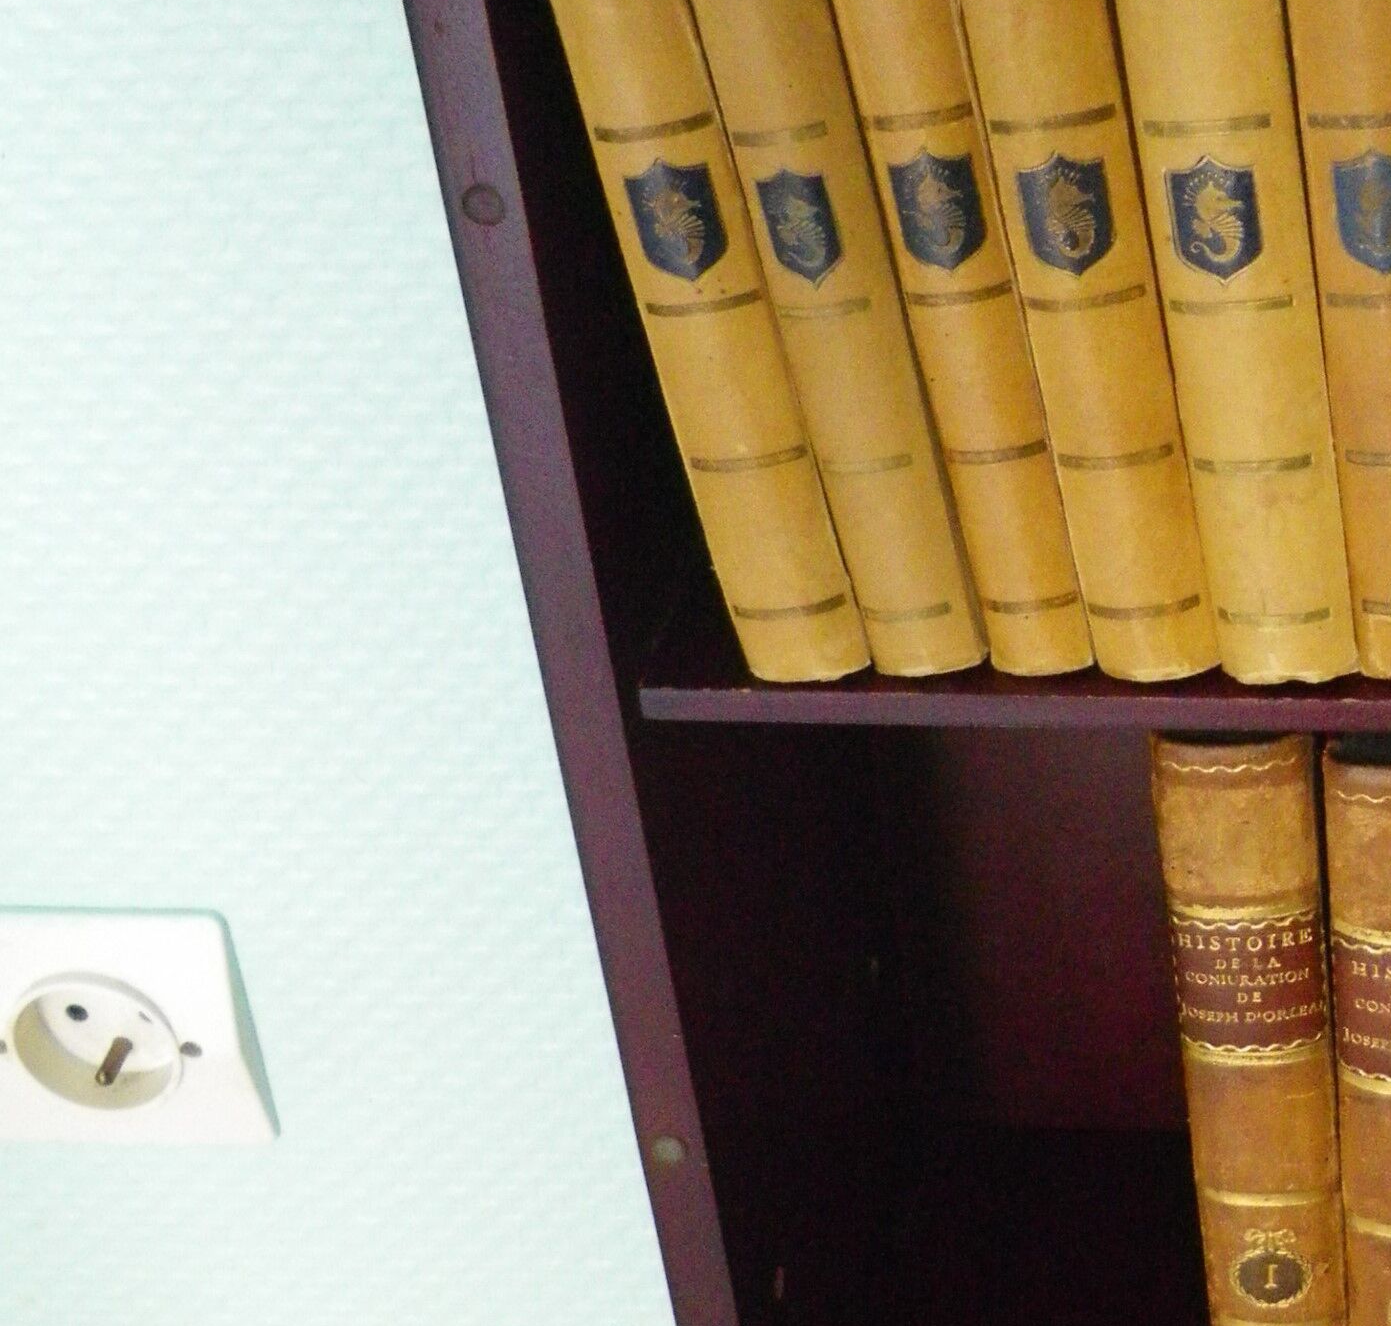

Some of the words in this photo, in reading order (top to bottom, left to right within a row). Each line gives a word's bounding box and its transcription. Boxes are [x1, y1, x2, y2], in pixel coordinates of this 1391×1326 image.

[1178, 927, 1313, 952] HISTOIRE
[1215, 958, 1241, 970] DE
[1253, 957, 1282, 969] LA
[1236, 991, 1263, 1004] DE
[1180, 1003, 1240, 1023] JOSEPH
[1263, 1263, 1279, 1289] I
